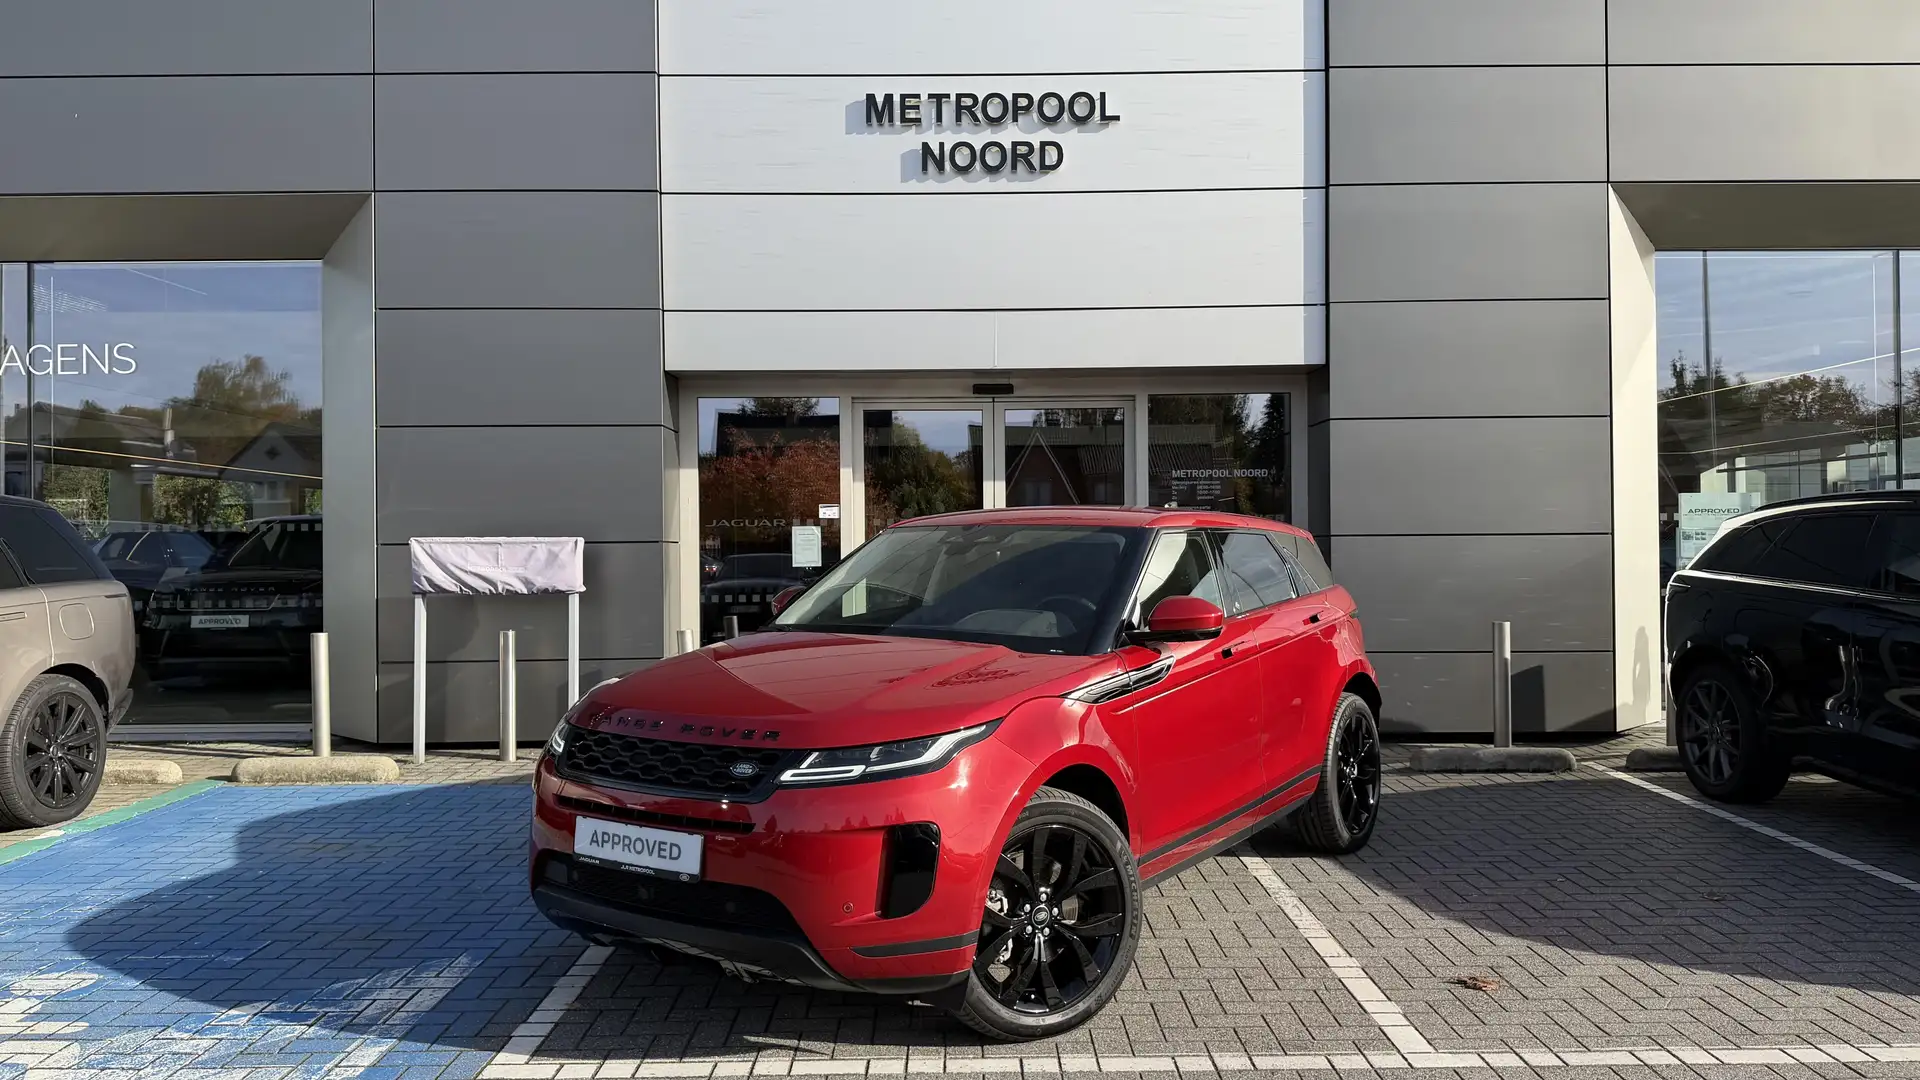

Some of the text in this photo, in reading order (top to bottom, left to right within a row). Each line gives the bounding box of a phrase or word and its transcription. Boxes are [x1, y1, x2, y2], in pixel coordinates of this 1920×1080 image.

[865, 91, 1121, 125] METROPOOL
[921, 140, 1064, 172] NOORD
[1172, 468, 1268, 478] METROPOOL NOORD
[705, 519, 787, 527] JAGUAR
[680, 723, 781, 742] ROVER
[589, 829, 682, 861] APPROVED
[579, 856, 600, 864] JAGUAR
[1125, 864, 1139, 938] MICHELIN
